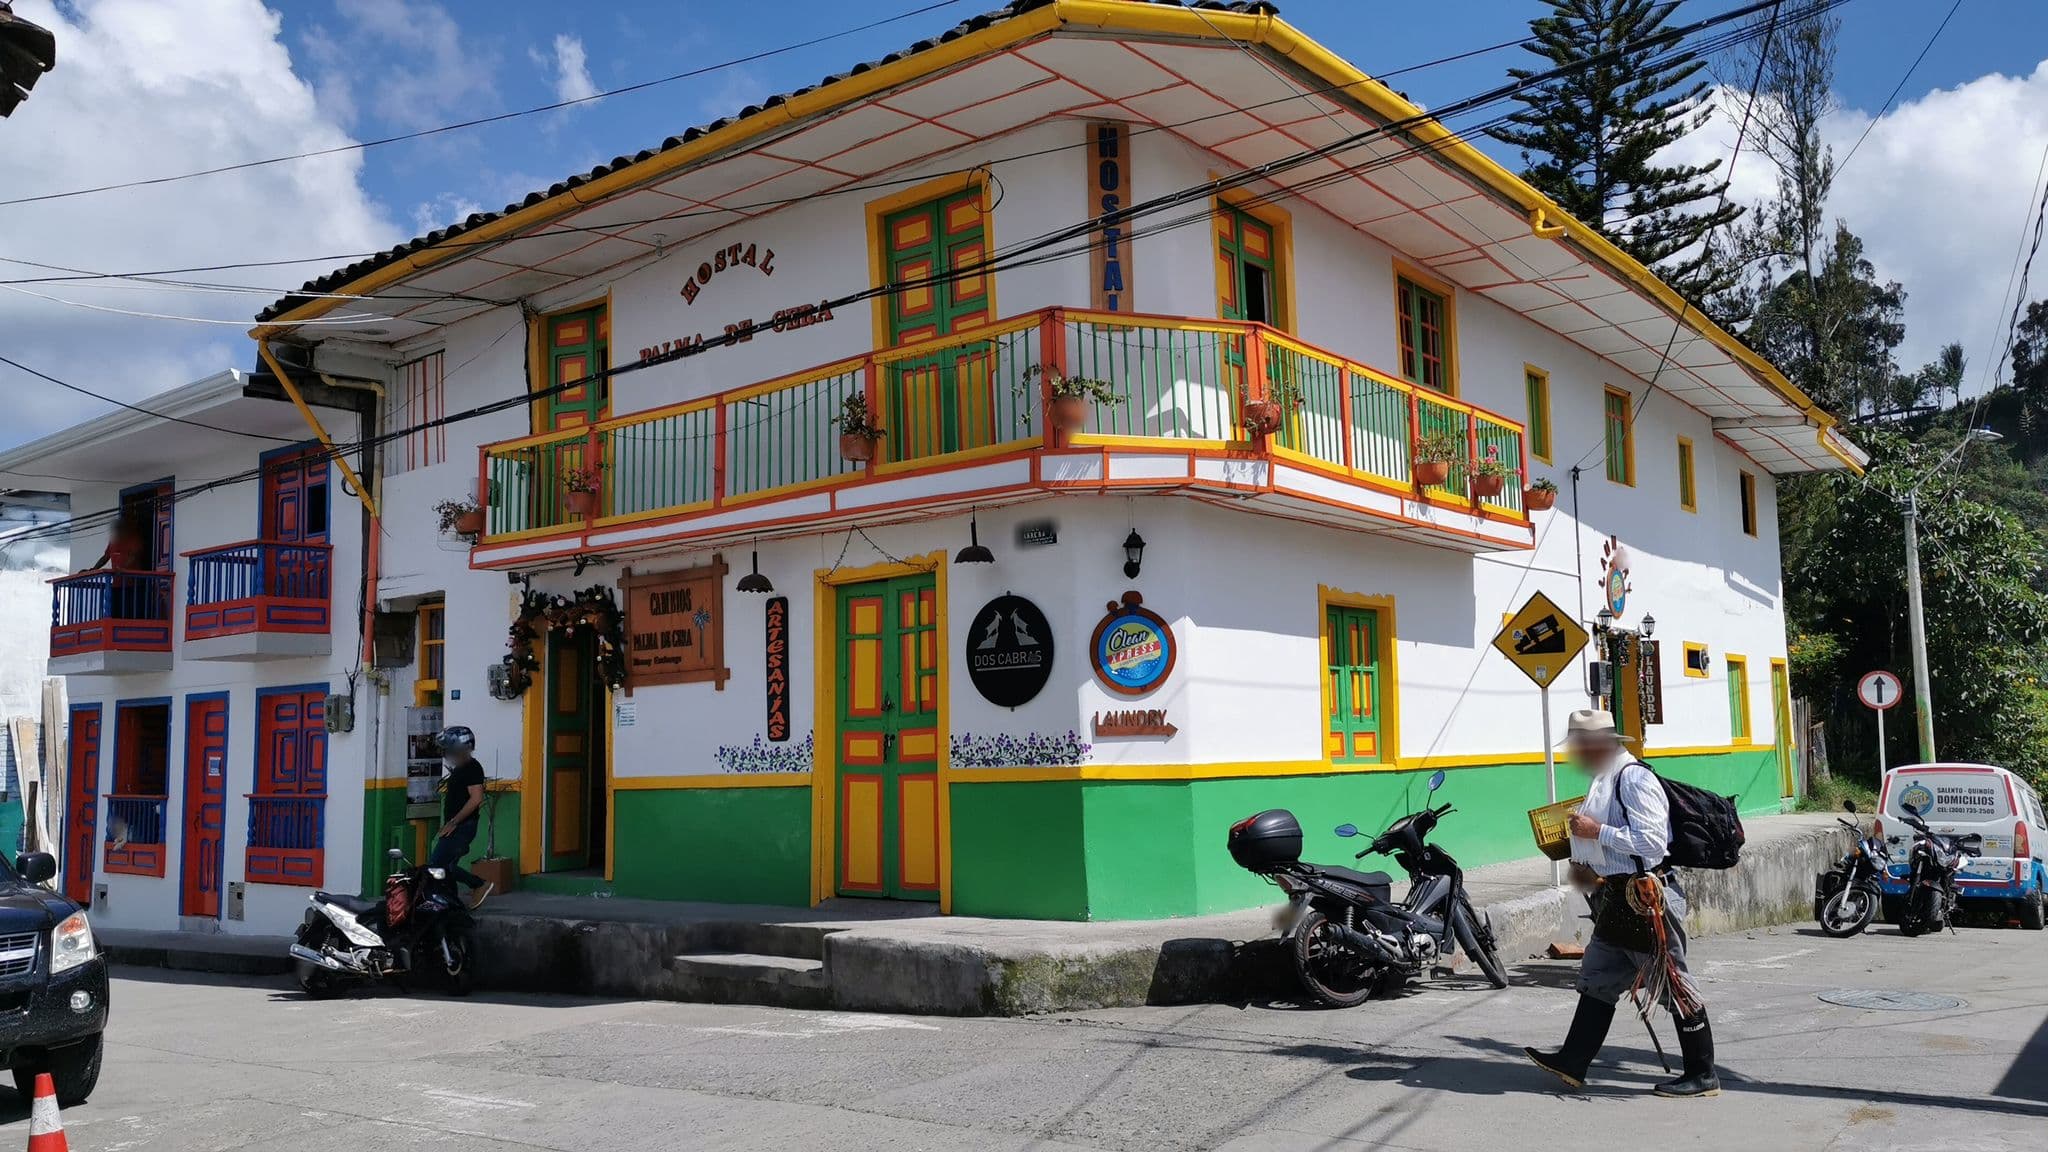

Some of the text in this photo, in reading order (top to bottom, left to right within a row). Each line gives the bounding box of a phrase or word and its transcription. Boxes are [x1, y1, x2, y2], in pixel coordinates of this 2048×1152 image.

[680, 242, 775, 306] HOSTAL
[723, 318, 753, 347] DE
[1599, 535, 1632, 592] LAUNRY
[650, 587, 693, 616] CAMBIOS
[633, 629, 693, 651] PALMA DE CERA
[1109, 628, 1149, 651] Clean
[975, 650, 1042, 667] DOS CABRAS
[1111, 642, 1155, 663] XPRESS
[1646, 656, 1657, 722] LAUNDRY
[1095, 709, 1167, 728] LAUNDRY
[1937, 795, 1994, 806] DOMICILIOS
